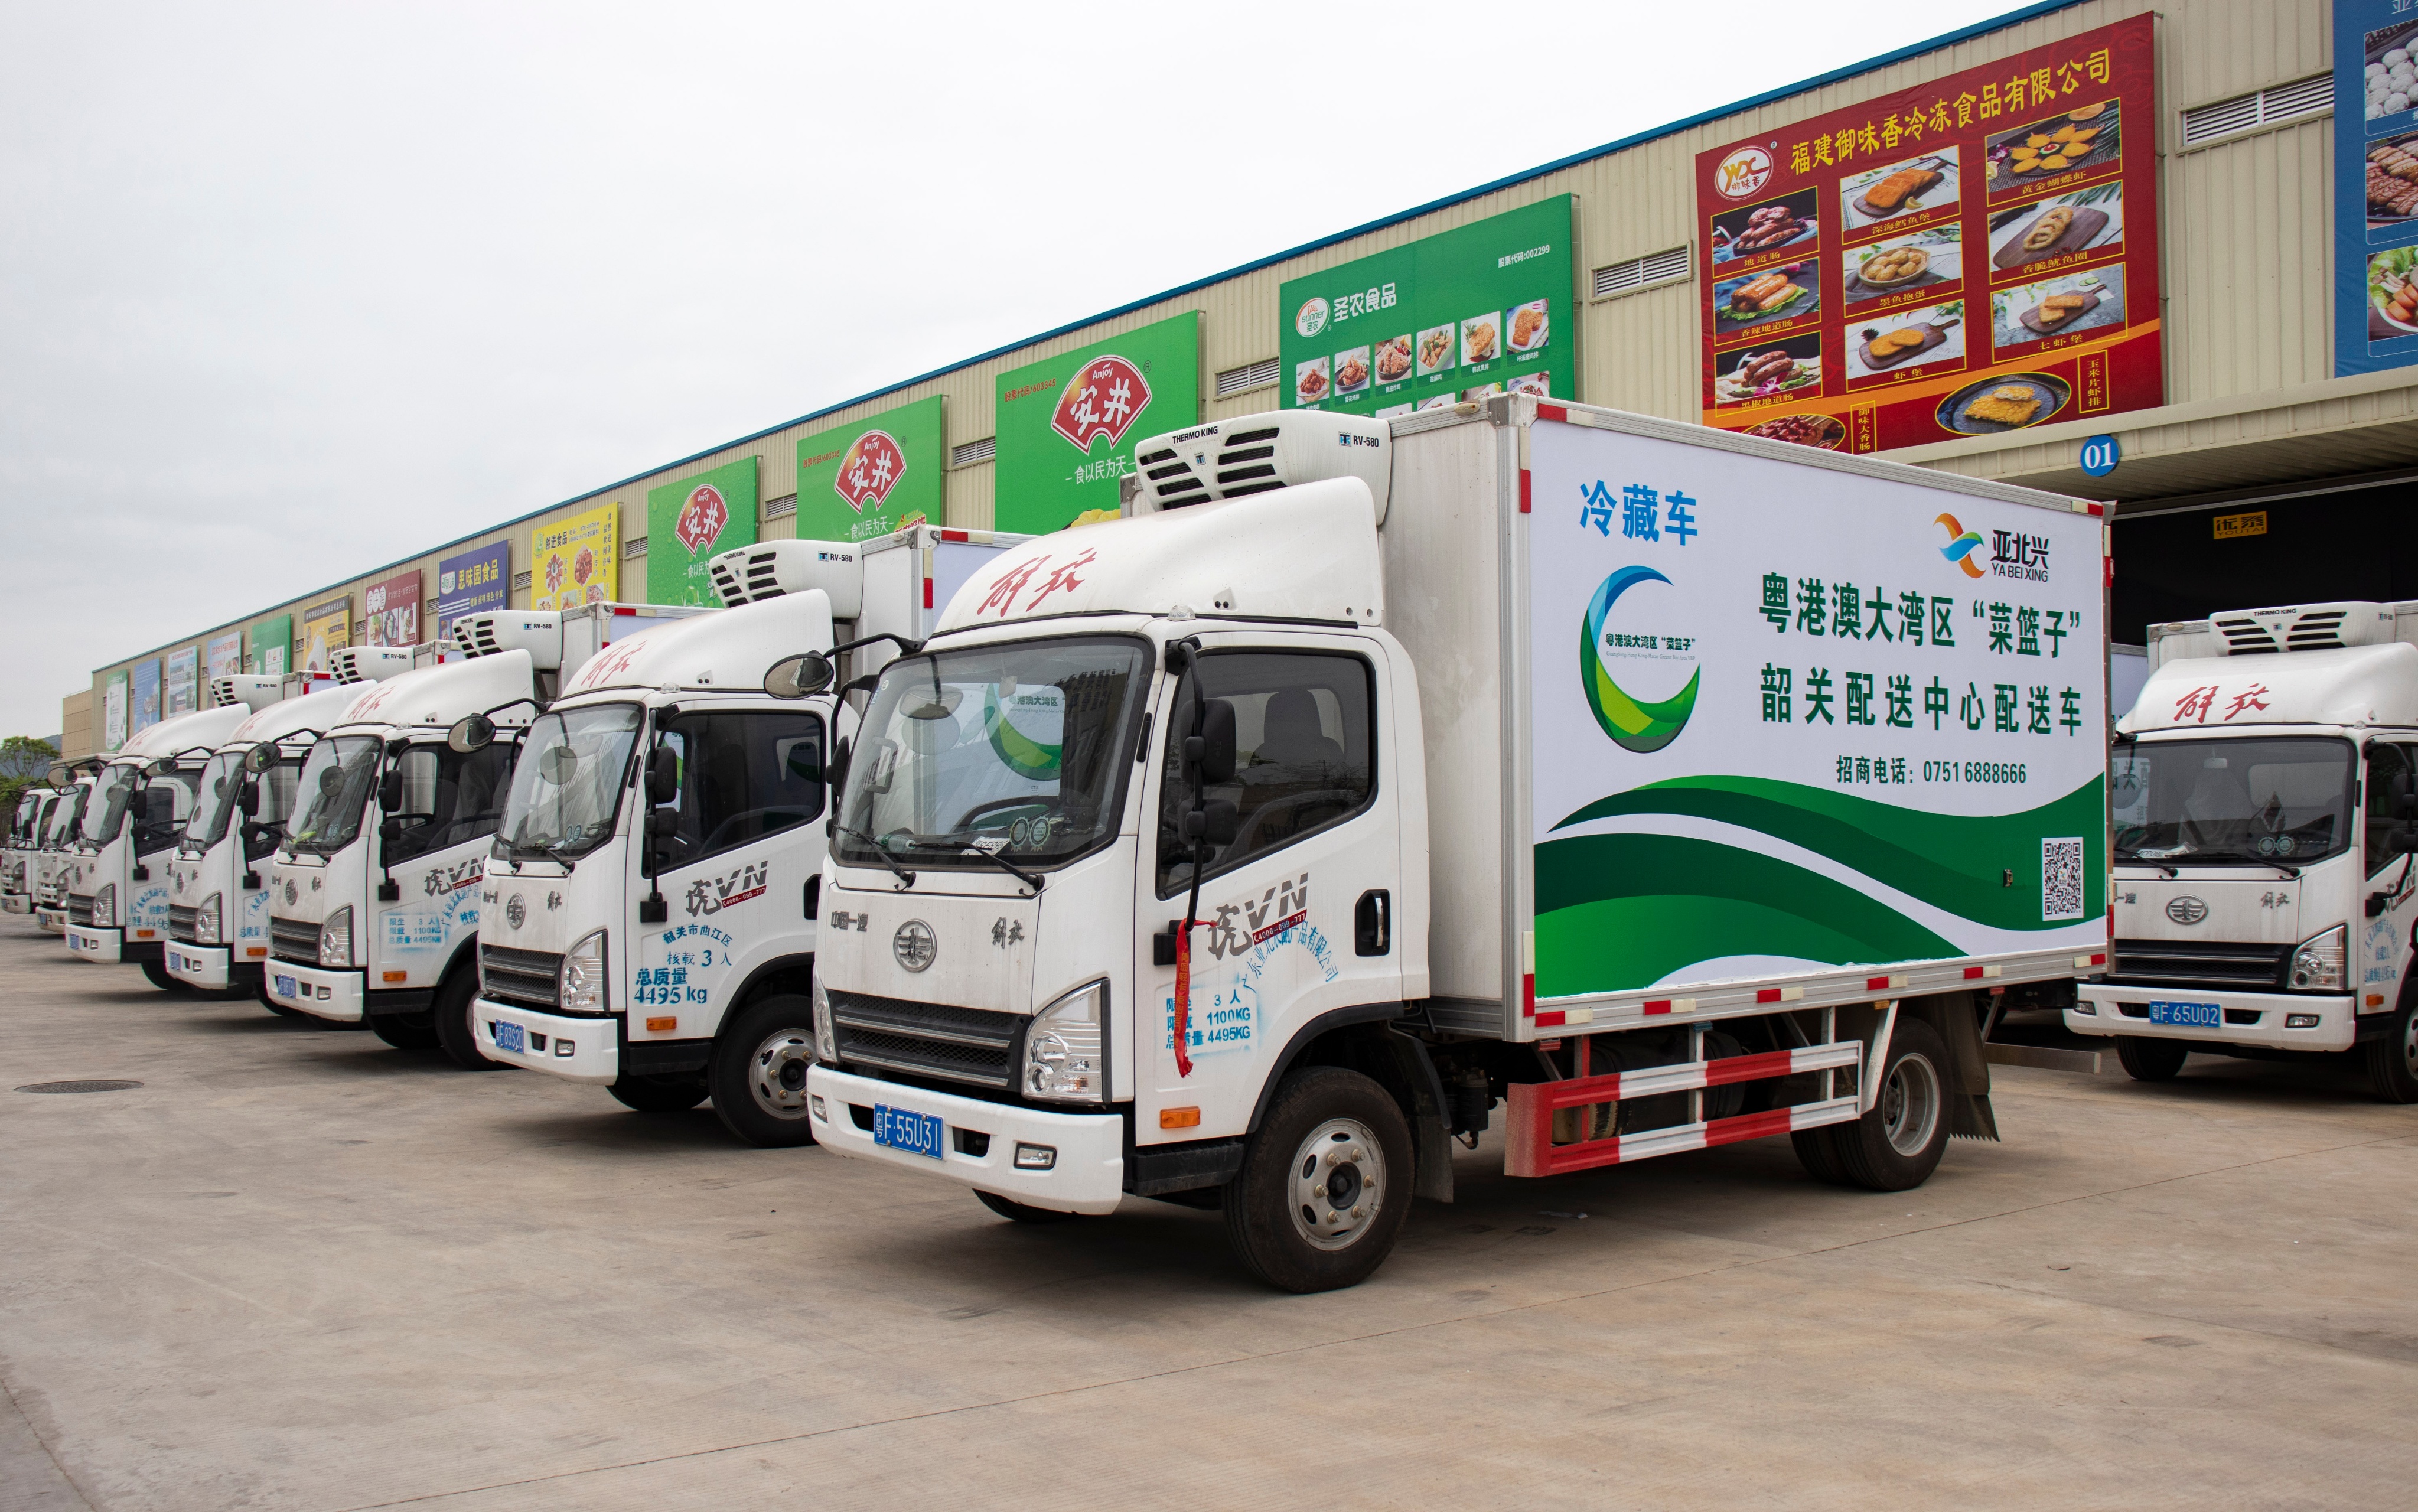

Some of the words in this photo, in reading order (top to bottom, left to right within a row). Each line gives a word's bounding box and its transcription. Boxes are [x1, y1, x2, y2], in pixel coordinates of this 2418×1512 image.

[1790, 48, 2110, 175] 福建御味香冷冻食品有限公司
[2021, 171, 2087, 195] 黄金蝴蝶虾
[1872, 213, 1930, 234] 深海鳕鱼堡
[1498, 245, 1550, 268] 股票代码:002299
[1744, 252, 1780, 265] 地道肠
[2023, 251, 2088, 273] 香脆鱿鱼圈
[1334, 282, 1396, 322] 圣农食品
[1879, 289, 1925, 307] 墨鱼抱蛋
[1302, 309, 1325, 323] sunner
[1306, 321, 1318, 332] 圣农
[1741, 320, 1793, 337] 香辣地道肠
[2038, 334, 2084, 350] 七虾堡
[1093, 367, 1113, 380] Anjoy
[1894, 368, 1922, 380] 虾堡
[2087, 359, 2101, 407] 玉米片虾排
[1005, 378, 1056, 402] 股票代码/603345
[1070, 377, 1131, 436] 安井
[1741, 394, 1793, 410] 黑椒地道肠
[1172, 430, 1200, 444] THERMO
[1201, 426, 1218, 438] KING
[1859, 408, 1870, 451] 御味大香肠
[865, 440, 879, 451] Anjoy
[1353, 435, 1379, 447] RV-580
[803, 450, 840, 468] 股票代码/603345
[2084, 442, 2114, 468] 01
[848, 449, 892, 498] 安井
[1074, 455, 1127, 485] 食以民为天
[686, 501, 718, 543] 安井
[1579, 479, 1699, 546] 冷藏车
[850, 516, 888, 539] 食以民为天
[2217, 514, 2264, 532] 优泰
[2217, 527, 2264, 536] YOUTAI
[545, 531, 567, 551] 然进食品
[1990, 529, 2049, 570] 亚北兴
[830, 554, 853, 562] RV-580
[458, 559, 498, 590] 思味园食品
[1992, 562, 2006, 577] YA
[2008, 565, 2023, 579] BEI
[2024, 567, 2049, 582] XING
[1760, 662, 2082, 737] 韶关配送中心配送车
[1964, 761, 2026, 784] 6888666
[726, 887, 766, 905] 4006-099-777
[667, 951, 695, 966] 核载
[701, 950, 712, 967] 3
[720, 952, 732, 966] 人
[636, 967, 689, 986] 总质量
[634, 986, 682, 1005] 4495
[686, 986, 708, 1003] kg
[1214, 994, 1221, 1006] 3
[1230, 989, 1240, 1005] 人
[1207, 1007, 1250, 1026] 1100KG
[1208, 1025, 1250, 1043] 4495KG
